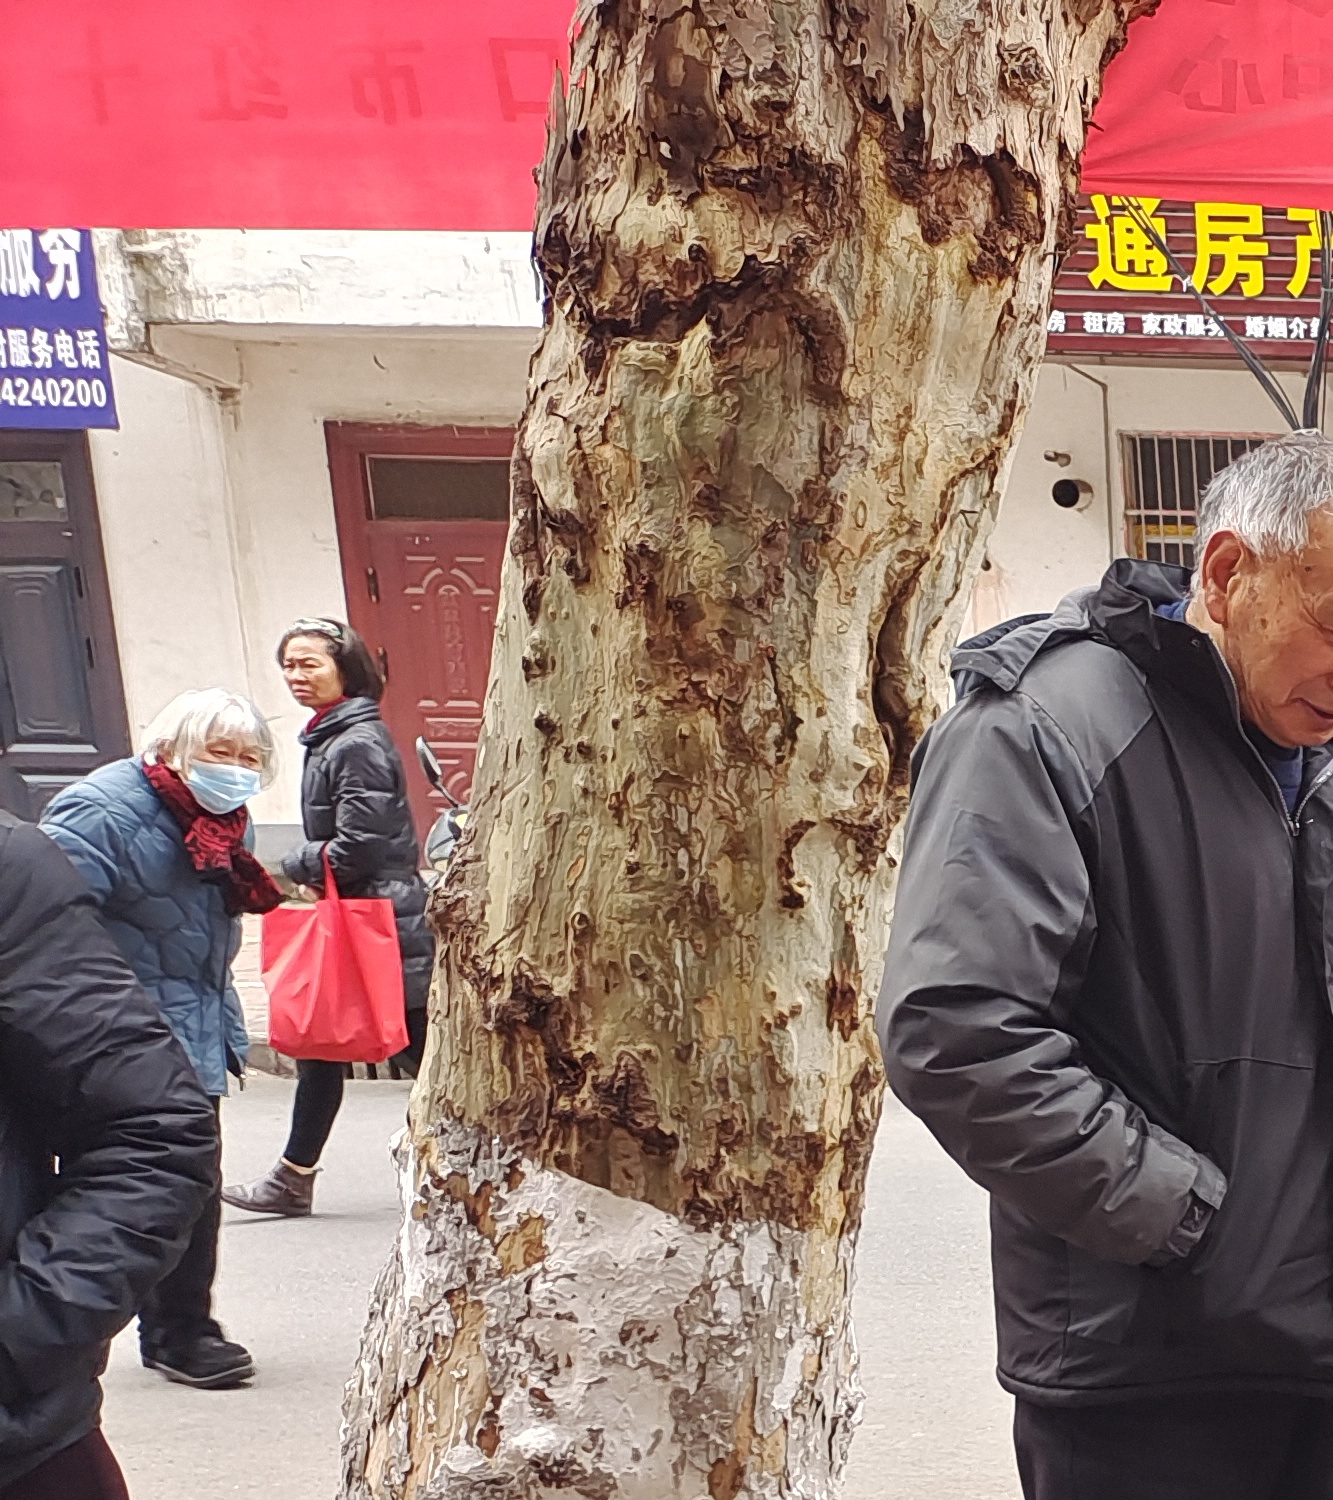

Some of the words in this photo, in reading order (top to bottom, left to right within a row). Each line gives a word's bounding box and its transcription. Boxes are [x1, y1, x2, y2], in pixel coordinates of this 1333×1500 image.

[1083, 311, 1125, 335] 租房
[1141, 312, 1226, 338] 家政服务
